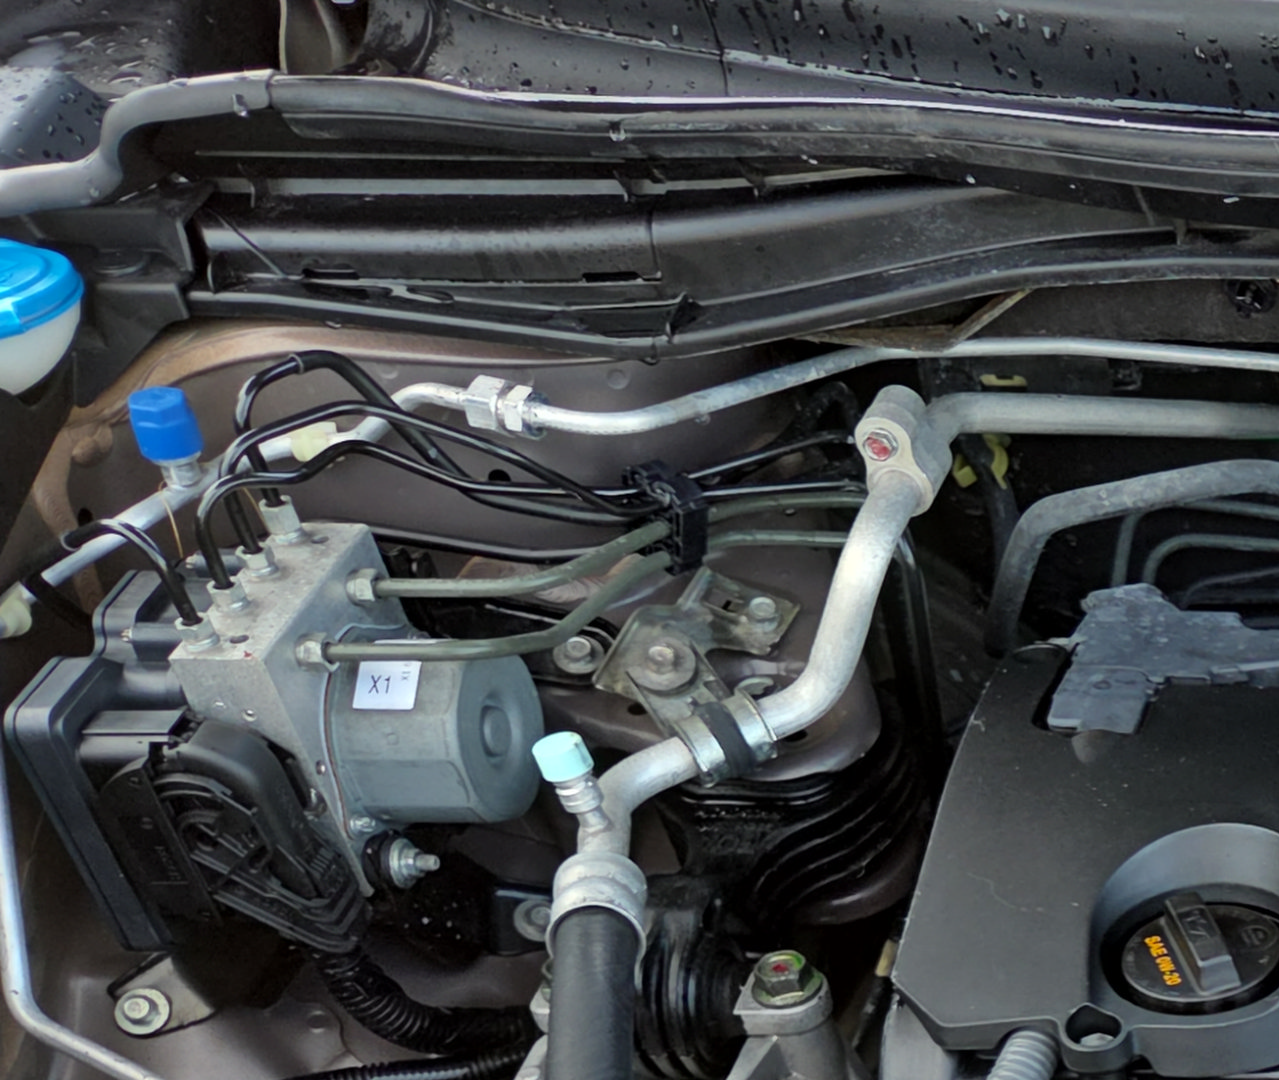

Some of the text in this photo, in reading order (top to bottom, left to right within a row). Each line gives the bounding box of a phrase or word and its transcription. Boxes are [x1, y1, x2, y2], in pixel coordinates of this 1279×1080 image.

[367, 674, 392, 695] X1
[1143, 935, 1182, 986] SAE 0W-20
